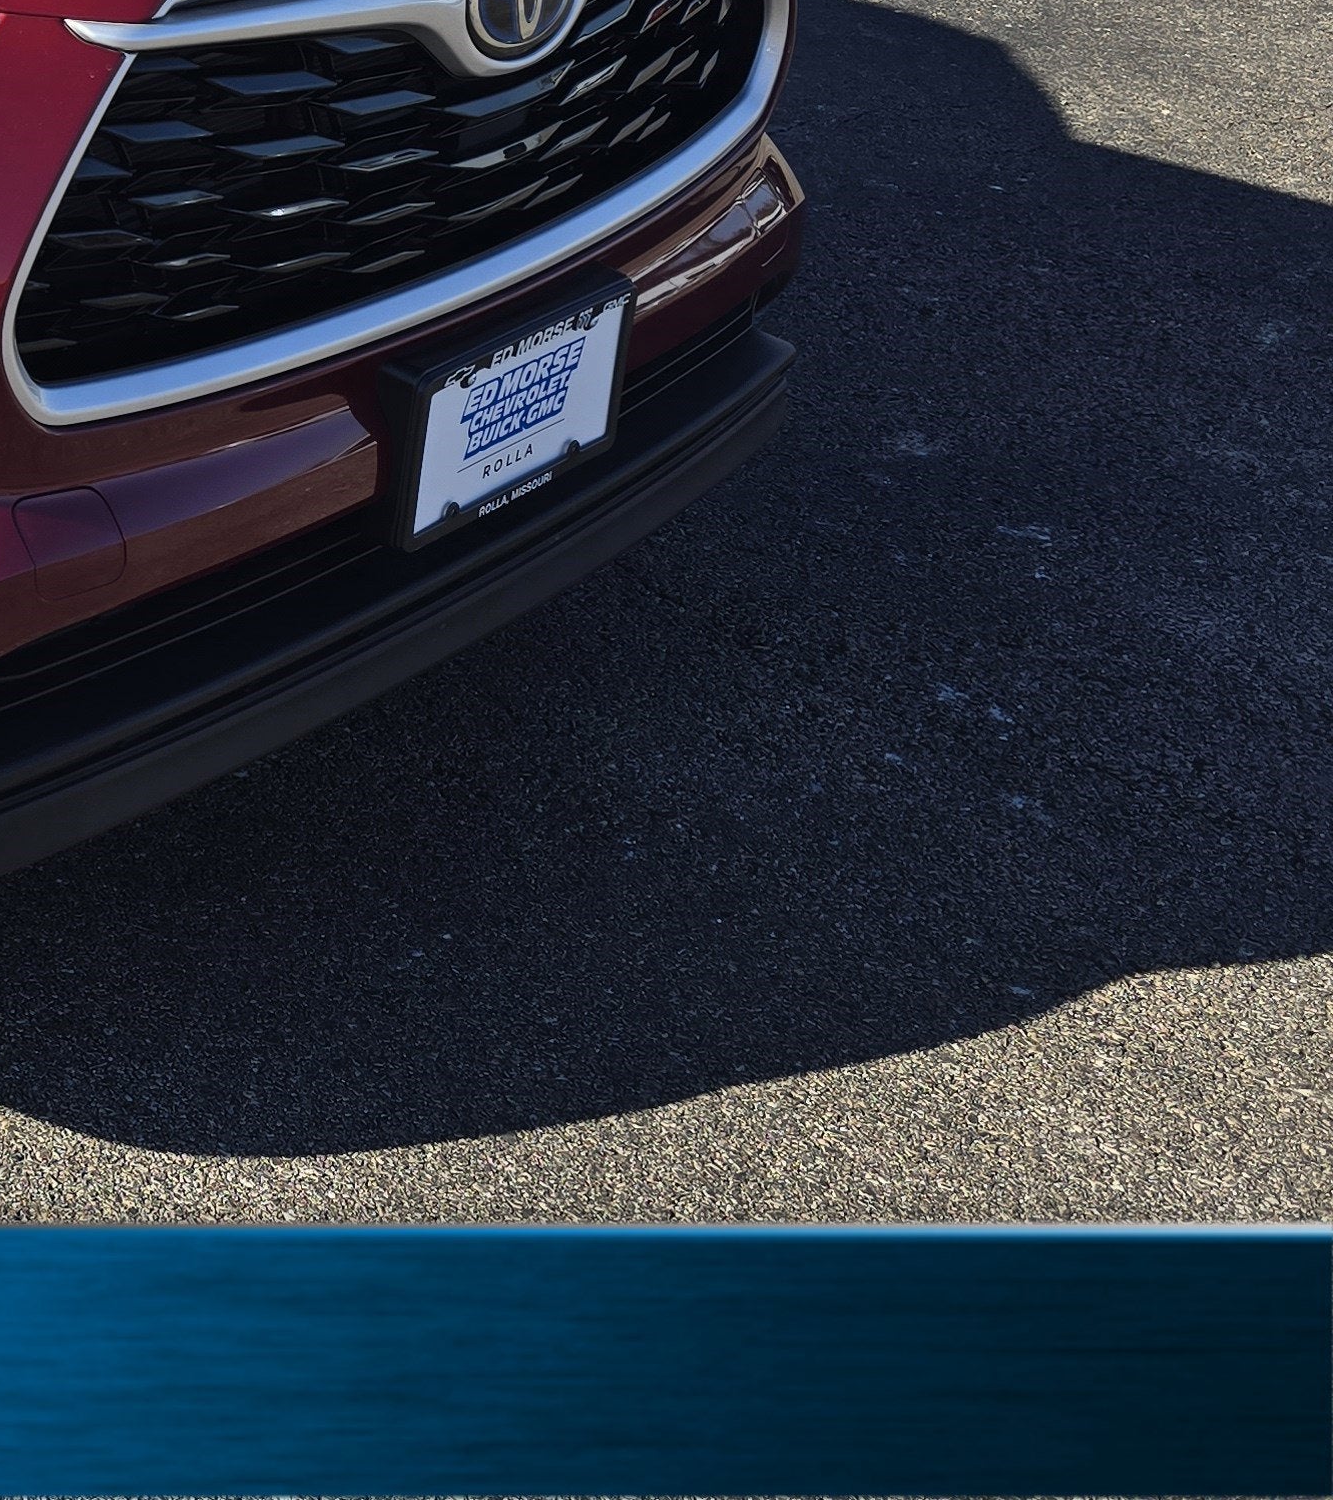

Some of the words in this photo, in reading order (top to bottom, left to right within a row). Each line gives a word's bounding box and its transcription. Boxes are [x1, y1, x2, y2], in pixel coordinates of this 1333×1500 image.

[490, 345, 515, 367] ED
[516, 316, 575, 356] MORSE
[463, 377, 501, 417] ED
[500, 343, 583, 400] MORSE
[468, 373, 571, 433] CHEVROLET
[483, 444, 533, 479] ROLLA
[479, 496, 509, 518] ROLLA,
[511, 470, 552, 501] MISSOURI
